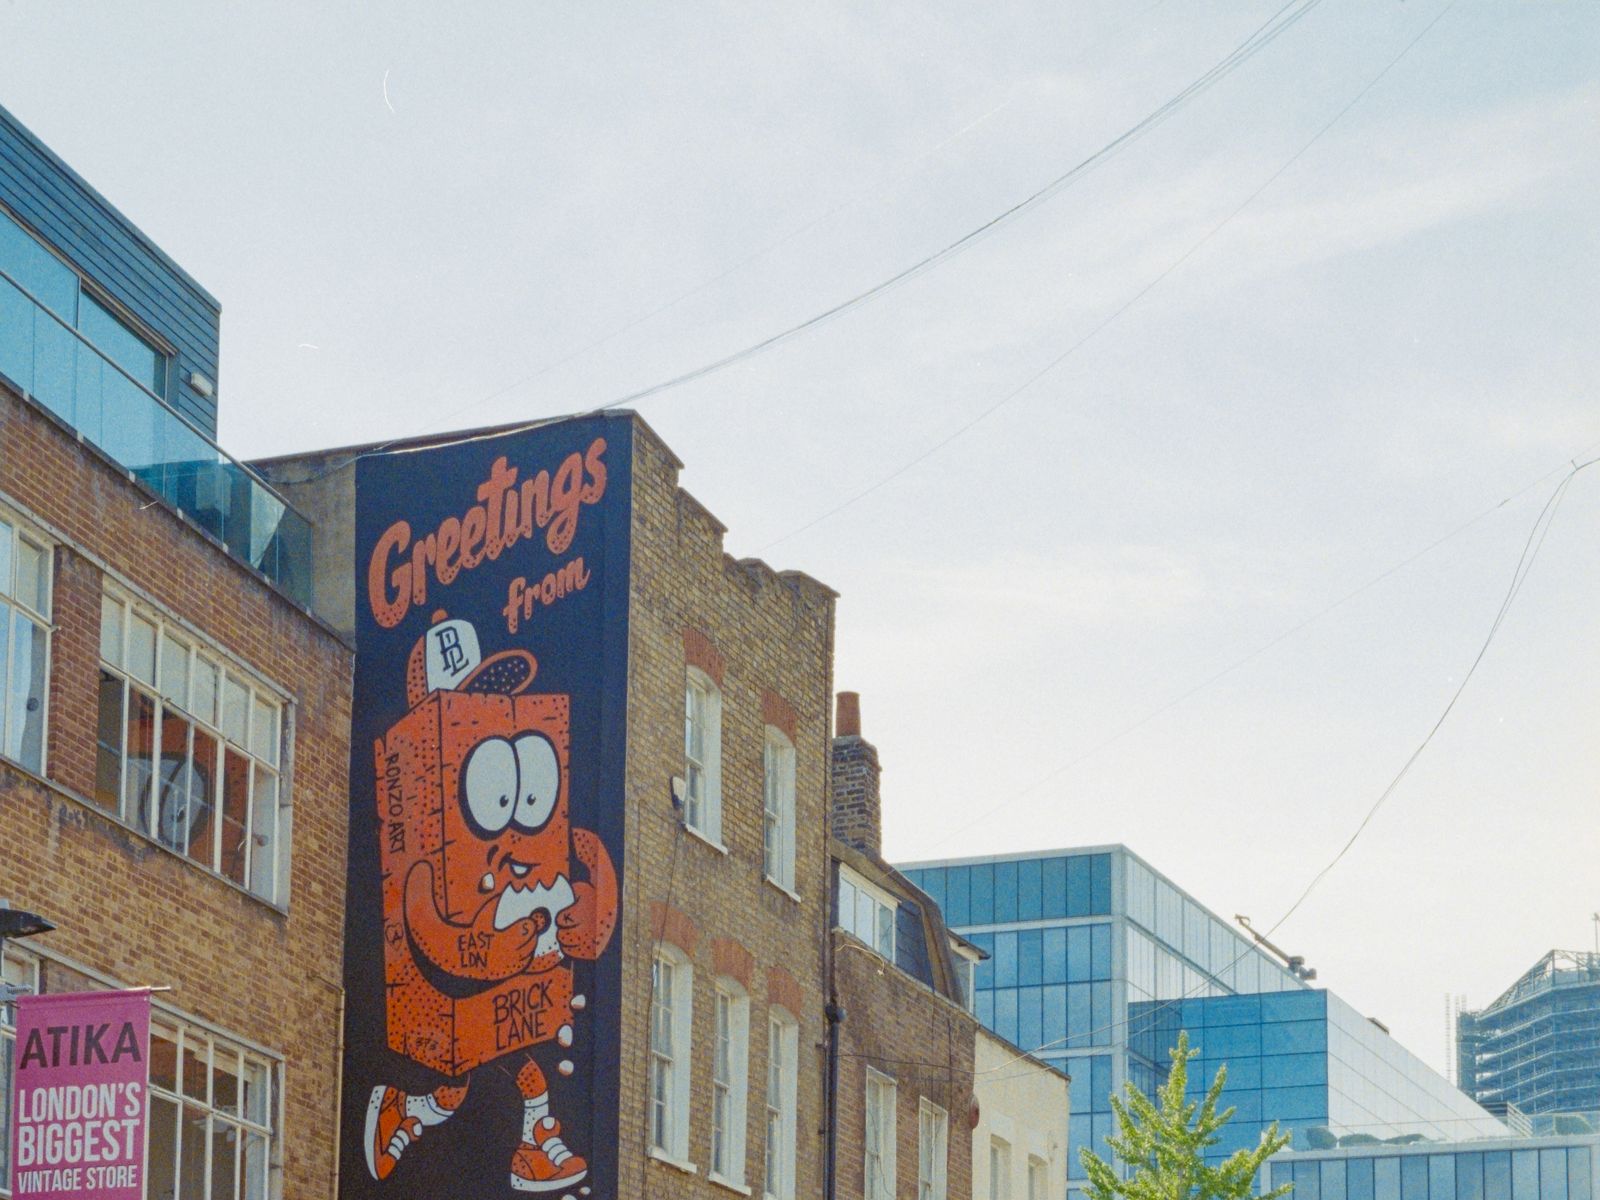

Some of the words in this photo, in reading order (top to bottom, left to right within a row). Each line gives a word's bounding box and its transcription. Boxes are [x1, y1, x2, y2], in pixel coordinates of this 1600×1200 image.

[368, 437, 607, 628] Greetings
[503, 557, 591, 634] from
[458, 931, 495, 952] EAST
[460, 952, 488, 968] LDN
[492, 979, 553, 1025] BRICK
[20, 1022, 142, 1070] ATIKA
[496, 1009, 548, 1051] LANE
[19, 1082, 141, 1123] LONDON'S
[18, 1119, 140, 1166] BIGGEST
[18, 1168, 82, 1193] VINTAGE
[86, 1165, 138, 1189] STORE
